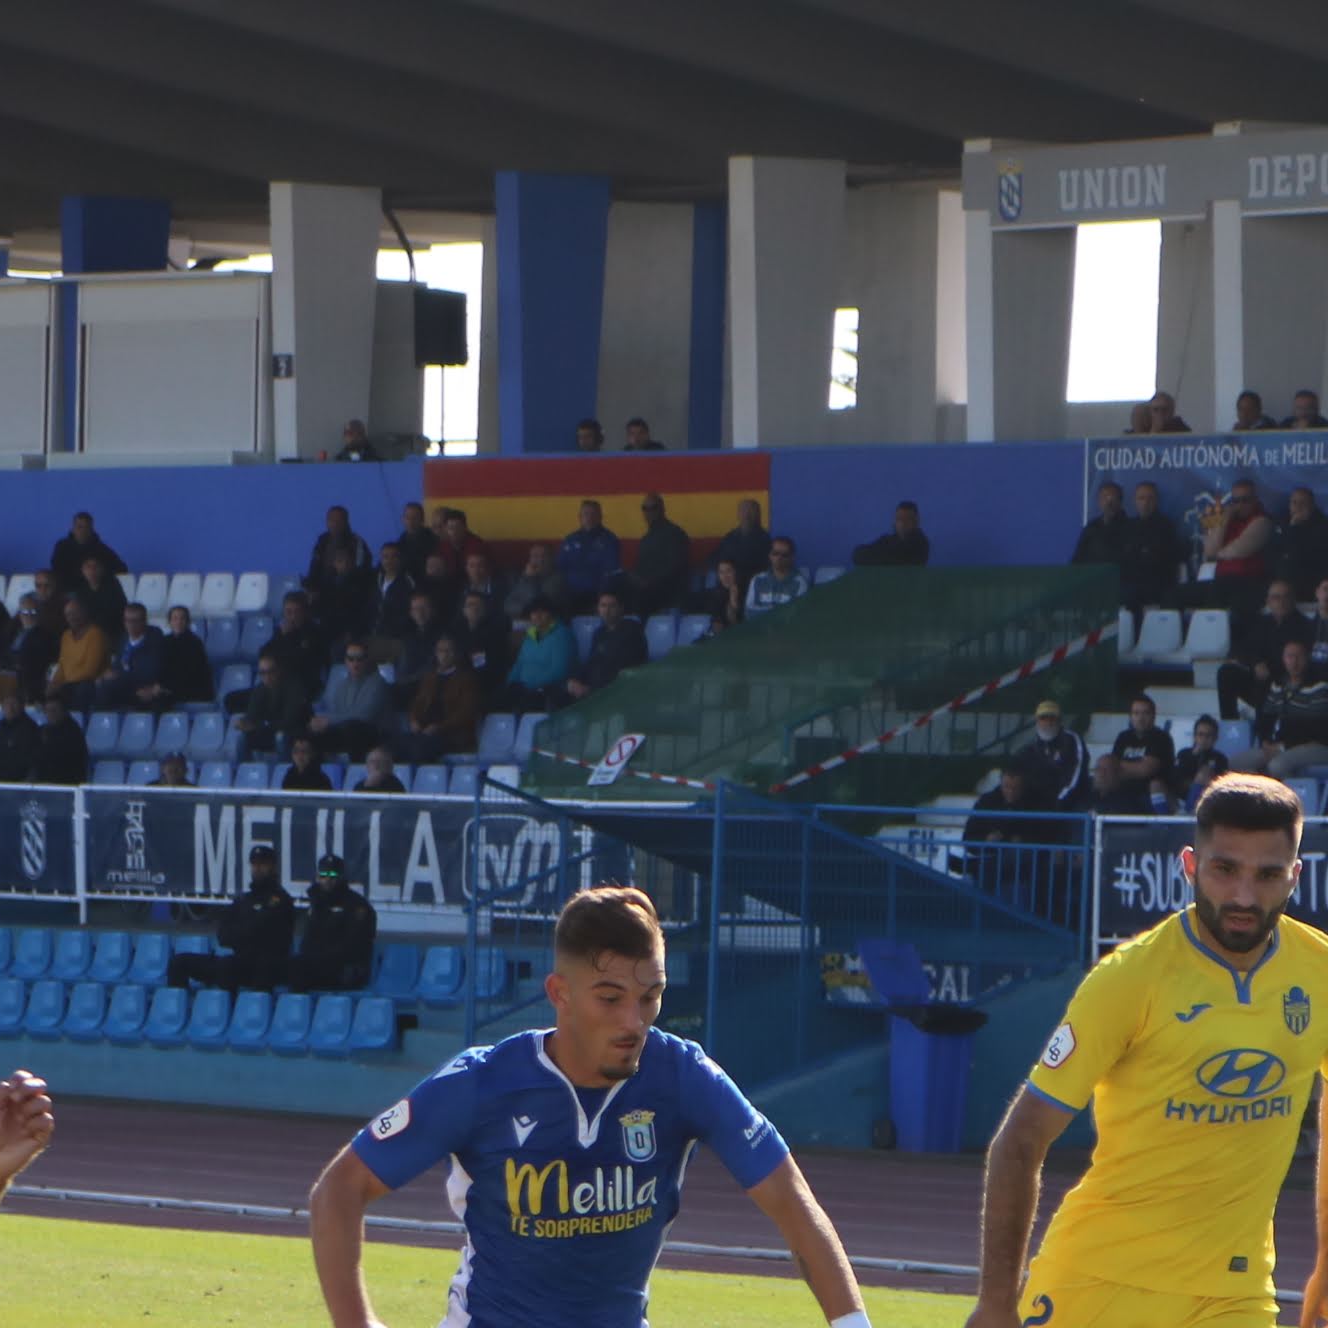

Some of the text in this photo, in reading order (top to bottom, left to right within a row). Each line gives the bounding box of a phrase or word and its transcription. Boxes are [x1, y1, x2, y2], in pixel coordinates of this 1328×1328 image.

[1057, 164, 1167, 211] UNION
[1094, 447, 1156, 471] CIUDAD
[1159, 440, 1260, 469] AUTÓNOMA
[1165, 1095, 1292, 1124] HYUNDAI
[505, 1157, 658, 1216] Melilla
[511, 1206, 654, 1239] TE SORPRENDERA
